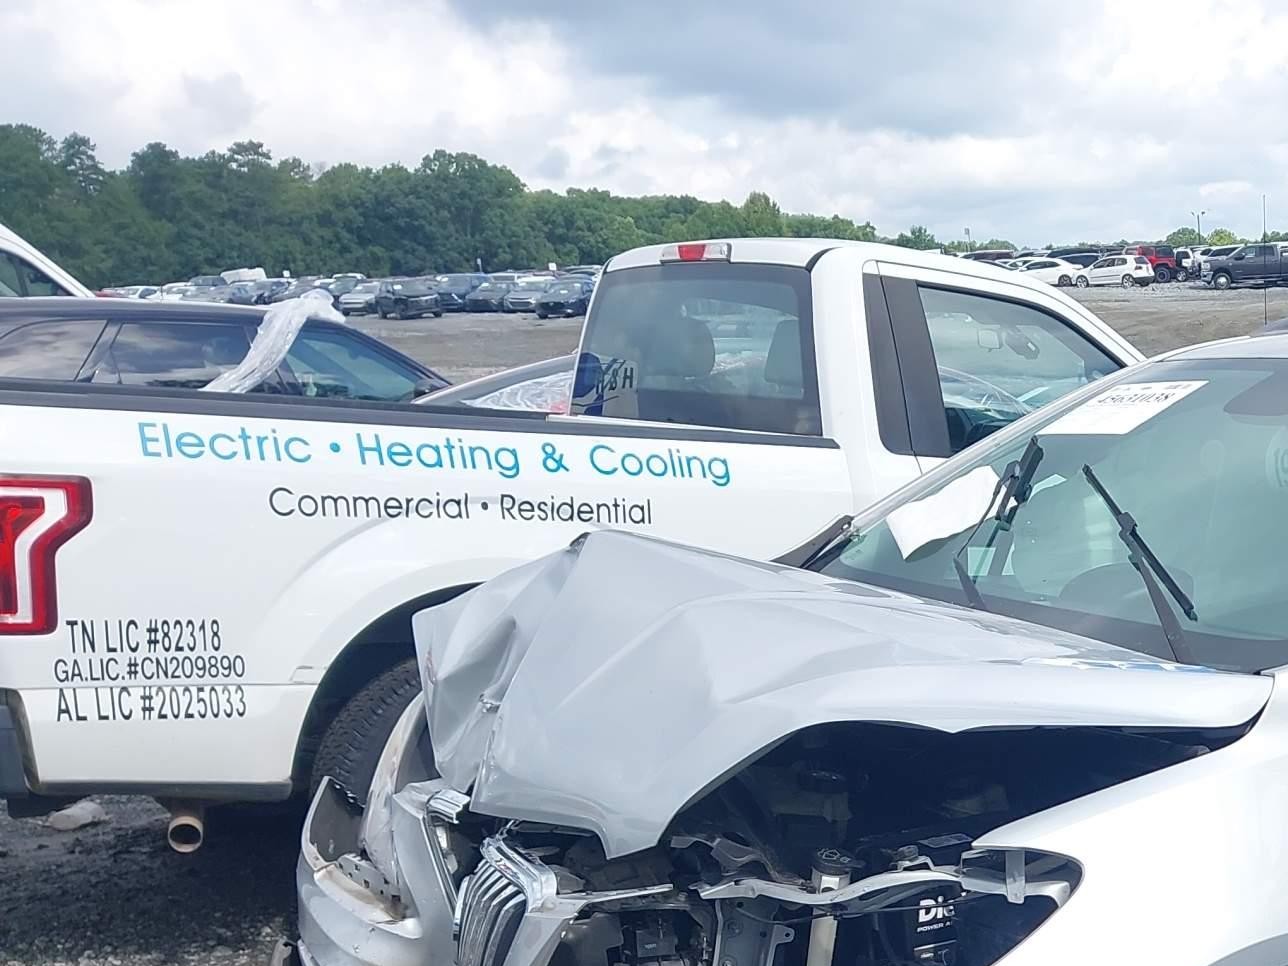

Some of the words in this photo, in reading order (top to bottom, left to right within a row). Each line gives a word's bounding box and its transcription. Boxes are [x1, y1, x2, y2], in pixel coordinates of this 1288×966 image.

[138, 422, 312, 463] Electric
[356, 432, 520, 479] Heating
[541, 442, 570, 473] &
[589, 444, 730, 487] Cooling
[269, 487, 470, 520] Commercial
[500, 493, 652, 525] Residential
[65, 619, 96, 654] TN
[104, 619, 140, 653] LIC
[146, 618, 221, 653] #82318
[57, 687, 88, 722] AL
[94, 686, 133, 721] LIC
[140, 685, 247, 721] #2025033
[917, 922, 945, 933] POWER
